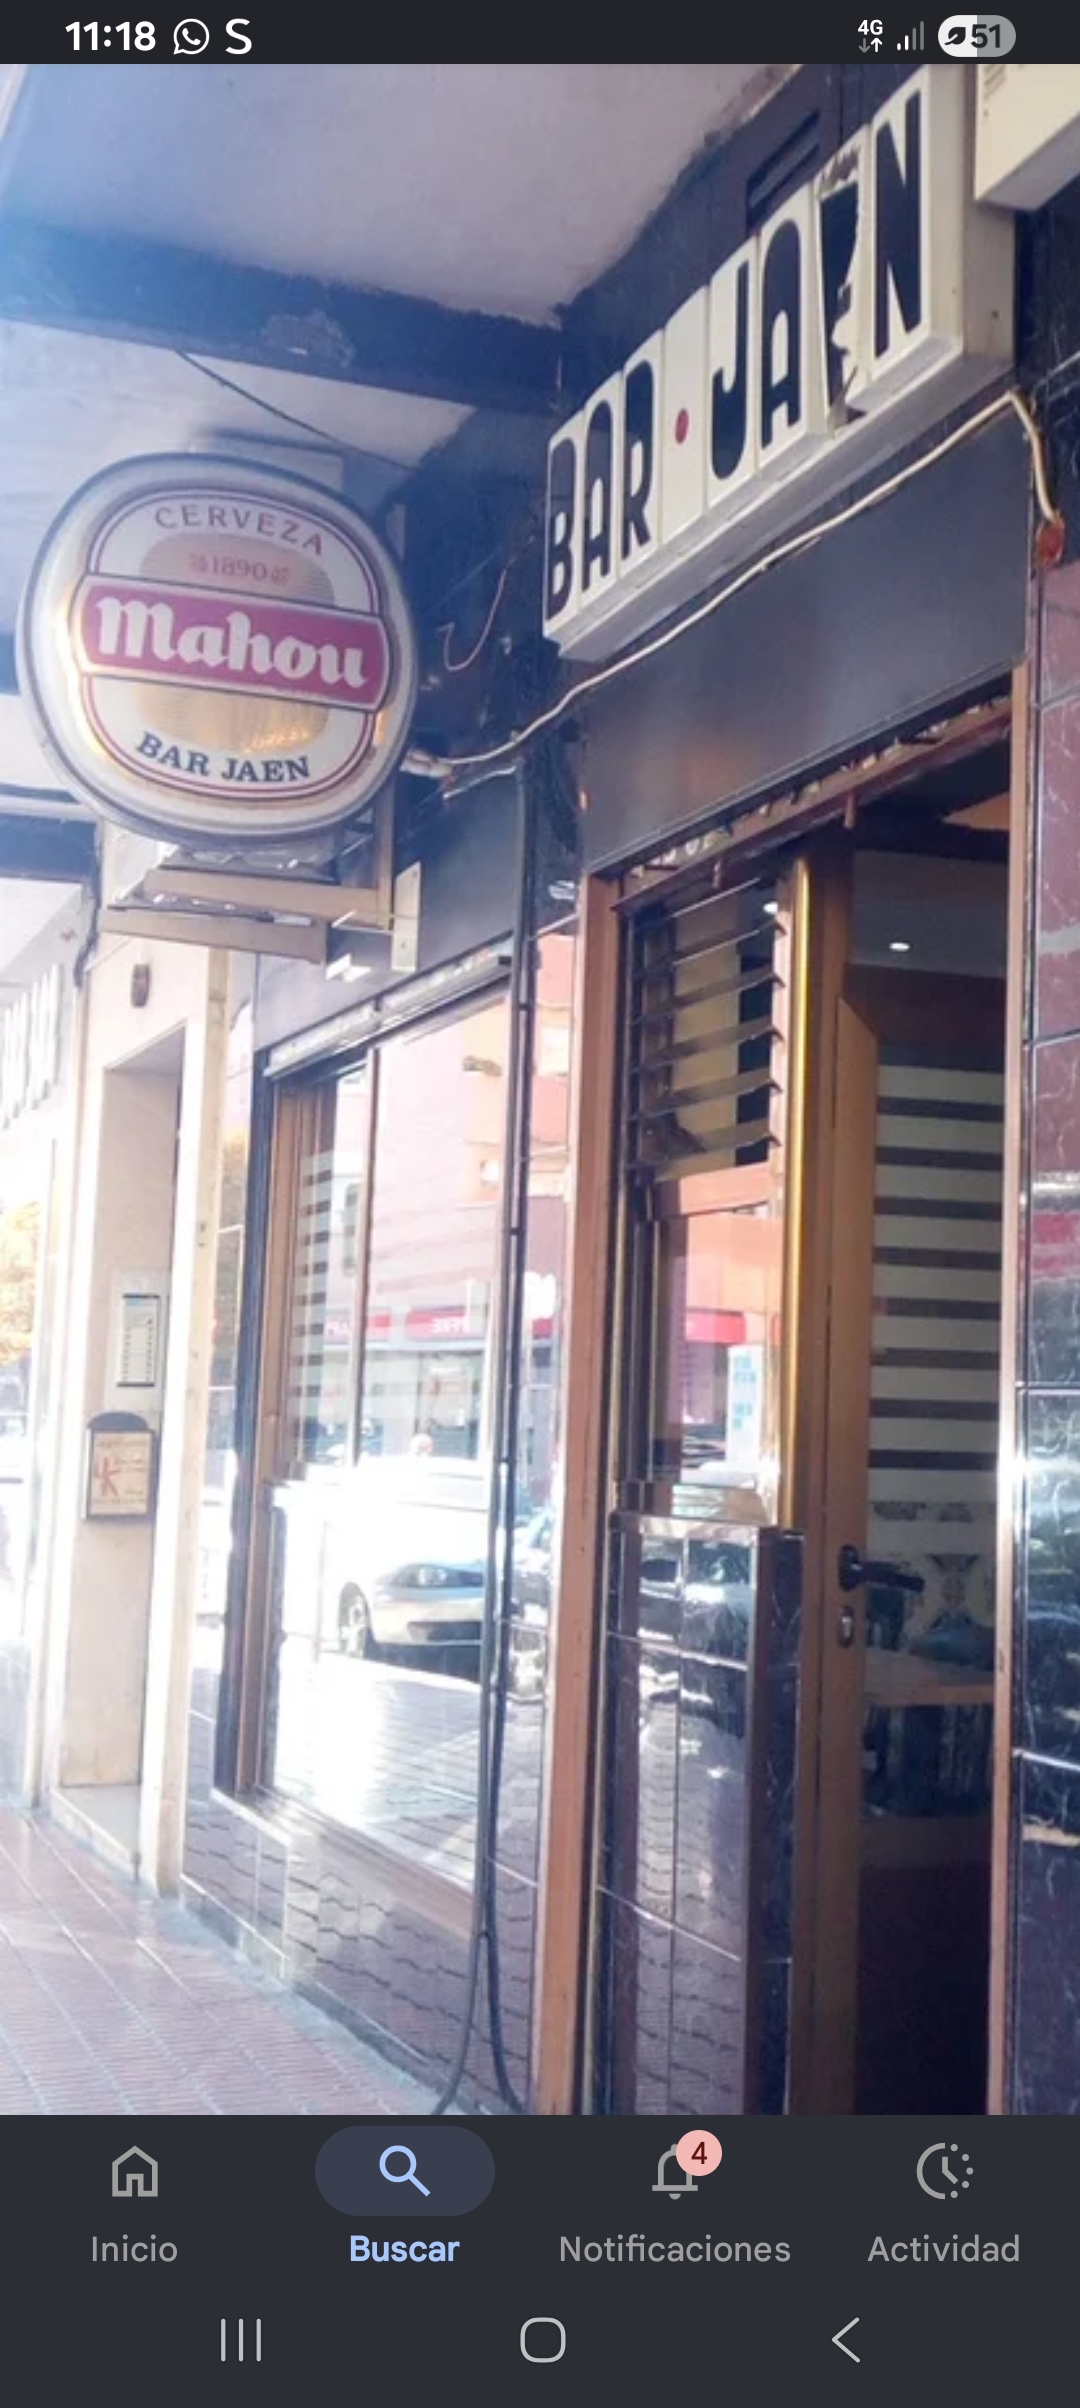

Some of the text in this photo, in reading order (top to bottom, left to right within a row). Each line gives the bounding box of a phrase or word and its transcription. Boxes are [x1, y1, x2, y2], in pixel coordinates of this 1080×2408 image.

[545, 89, 922, 621] BAR JAN
[154, 504, 323, 556] CERVEZA
[211, 555, 267, 582] 1890
[96, 596, 366, 688] Mahou
[136, 731, 311, 783] BAR JAEN
